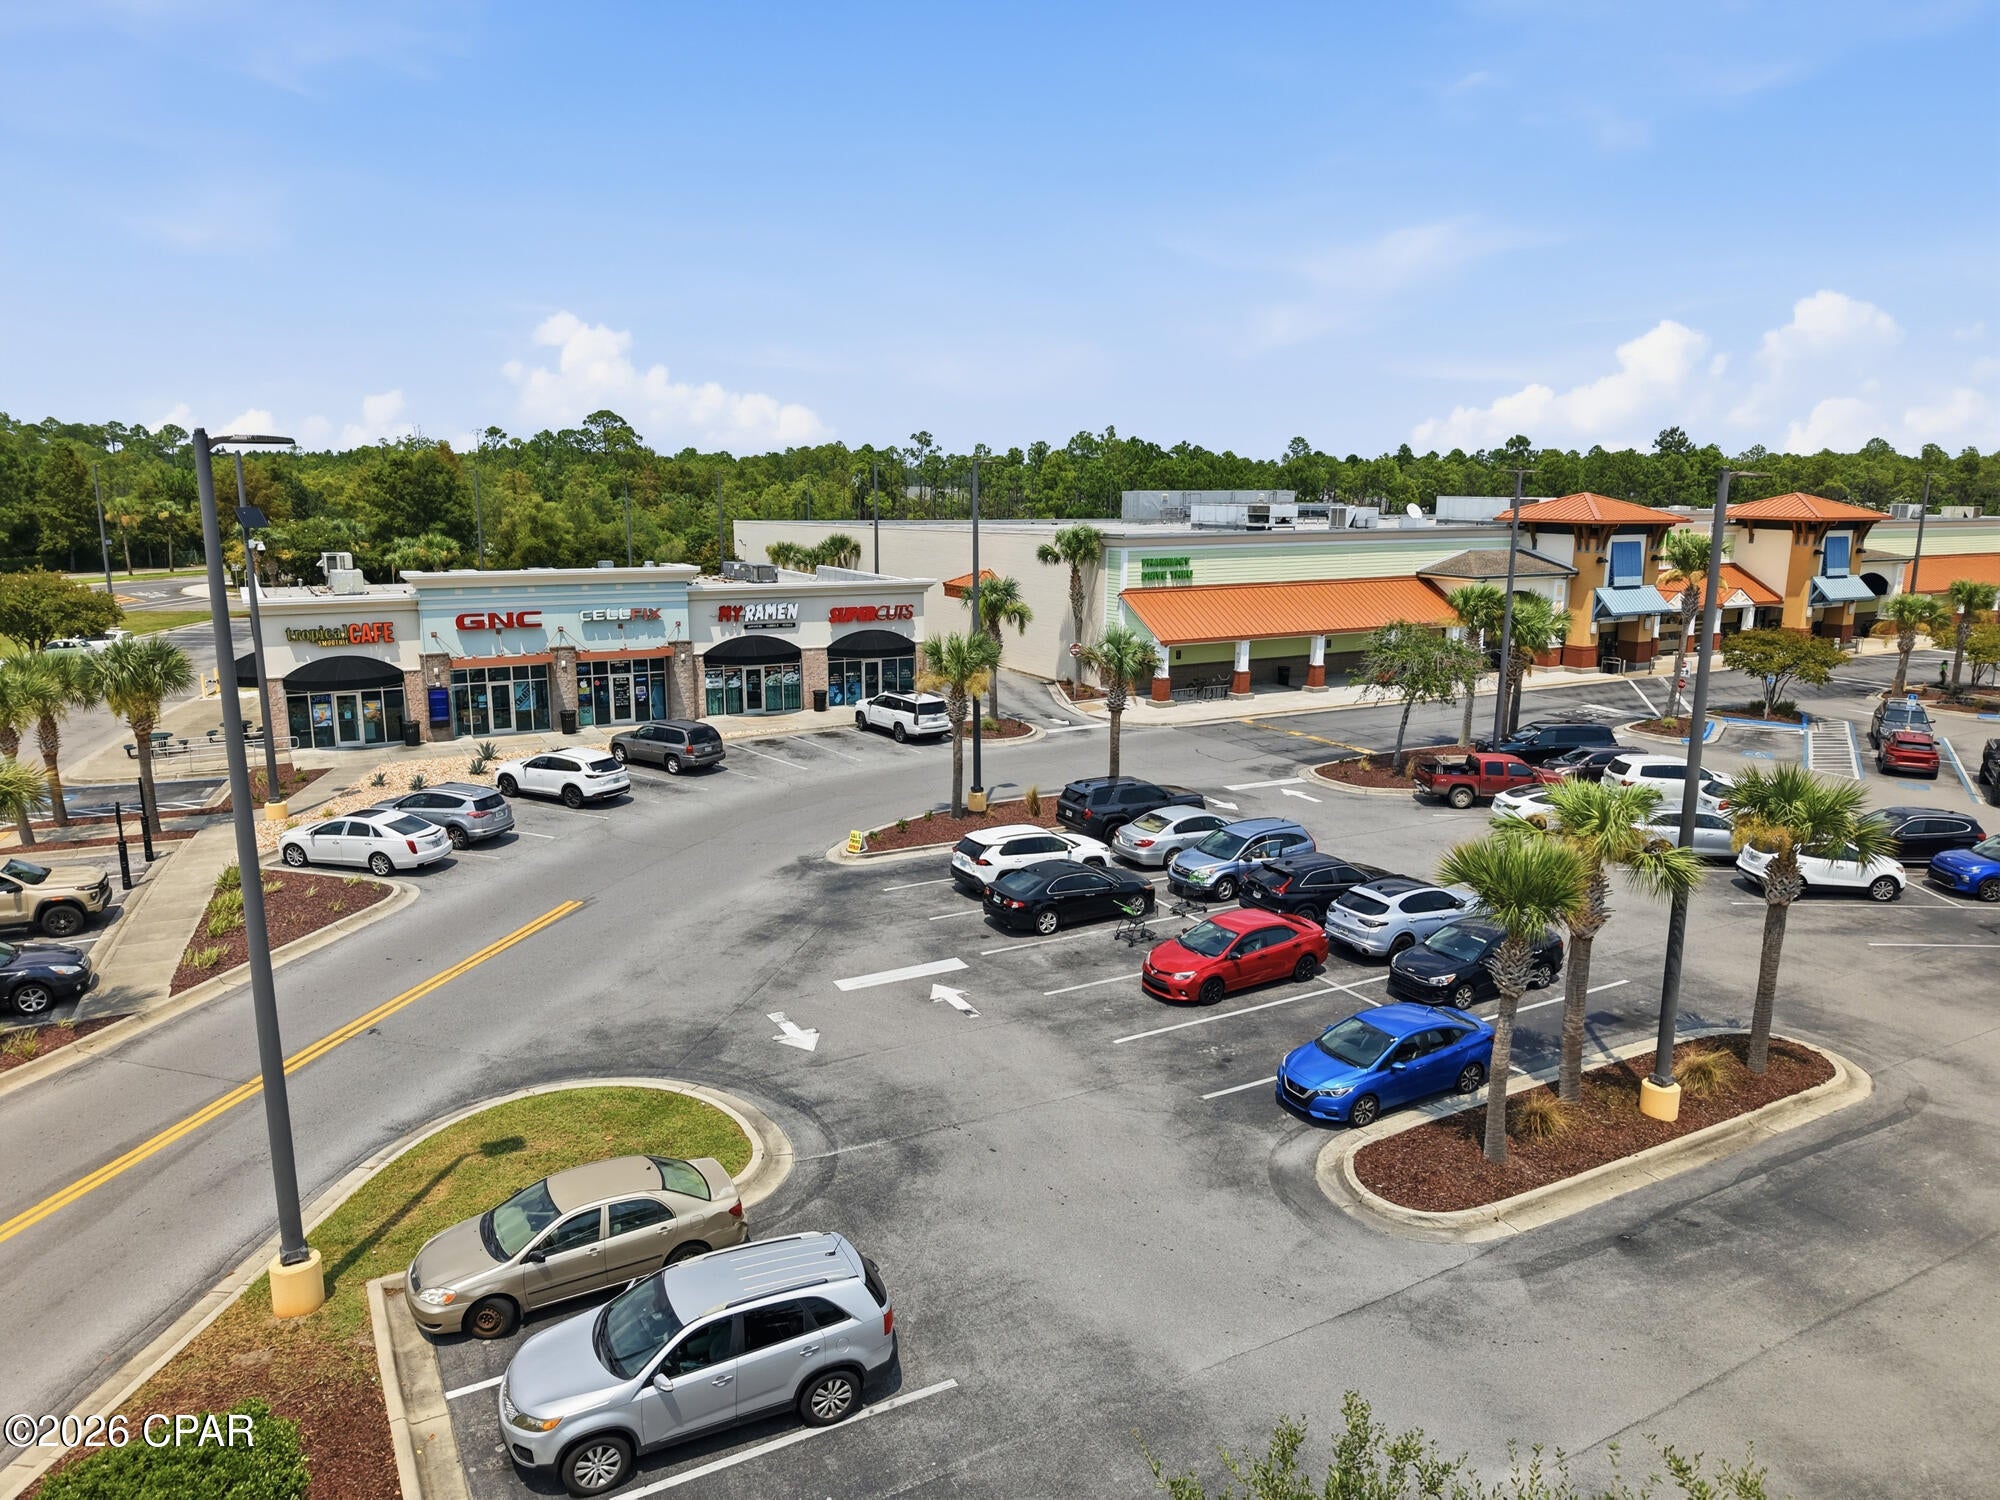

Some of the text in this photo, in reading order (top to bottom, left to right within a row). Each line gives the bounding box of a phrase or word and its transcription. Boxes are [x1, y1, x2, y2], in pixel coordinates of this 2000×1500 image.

[1141, 571, 1167, 581] DRIVE
[455, 611, 543, 631] GNC
[718, 602, 799, 622] MY RAMEN
[285, 621, 394, 645] tropical CAFE
